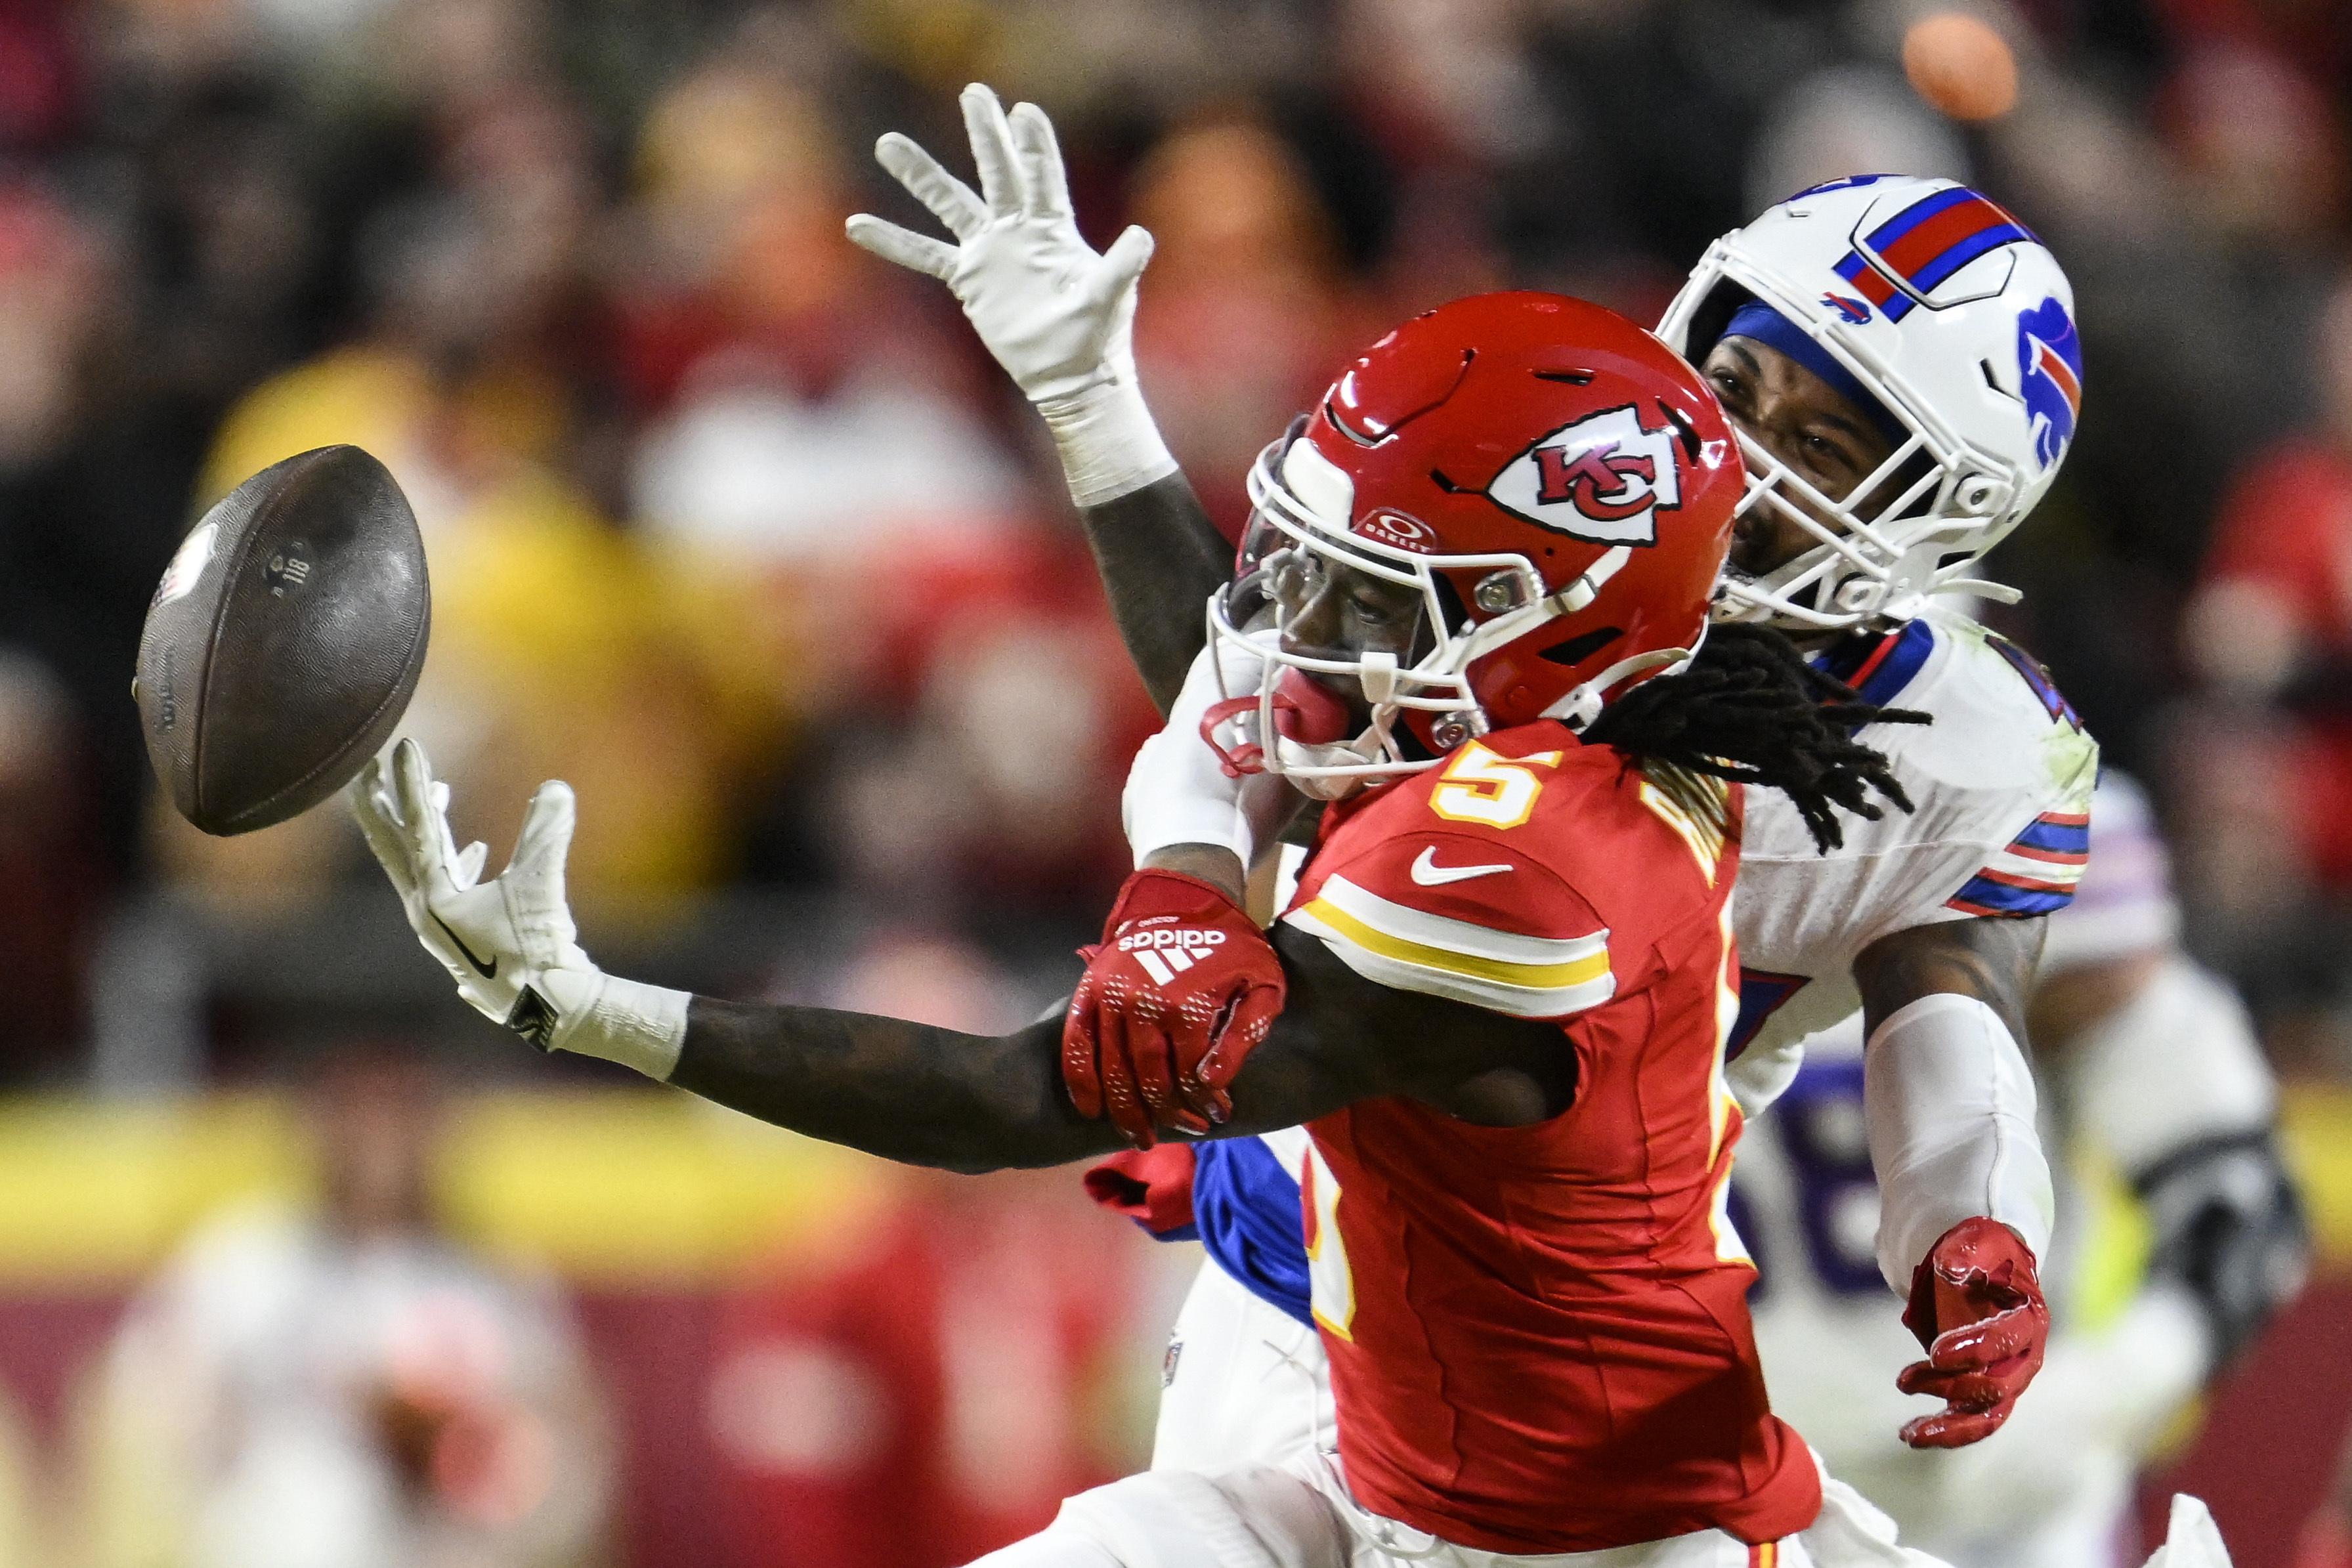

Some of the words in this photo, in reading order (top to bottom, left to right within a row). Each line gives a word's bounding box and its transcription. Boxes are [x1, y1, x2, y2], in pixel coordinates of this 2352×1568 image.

[1531, 440, 1656, 522] KC
[1365, 523, 1431, 553] OAKLEY
[1428, 738, 1564, 830] 5
[1118, 929, 1226, 952] adidas
